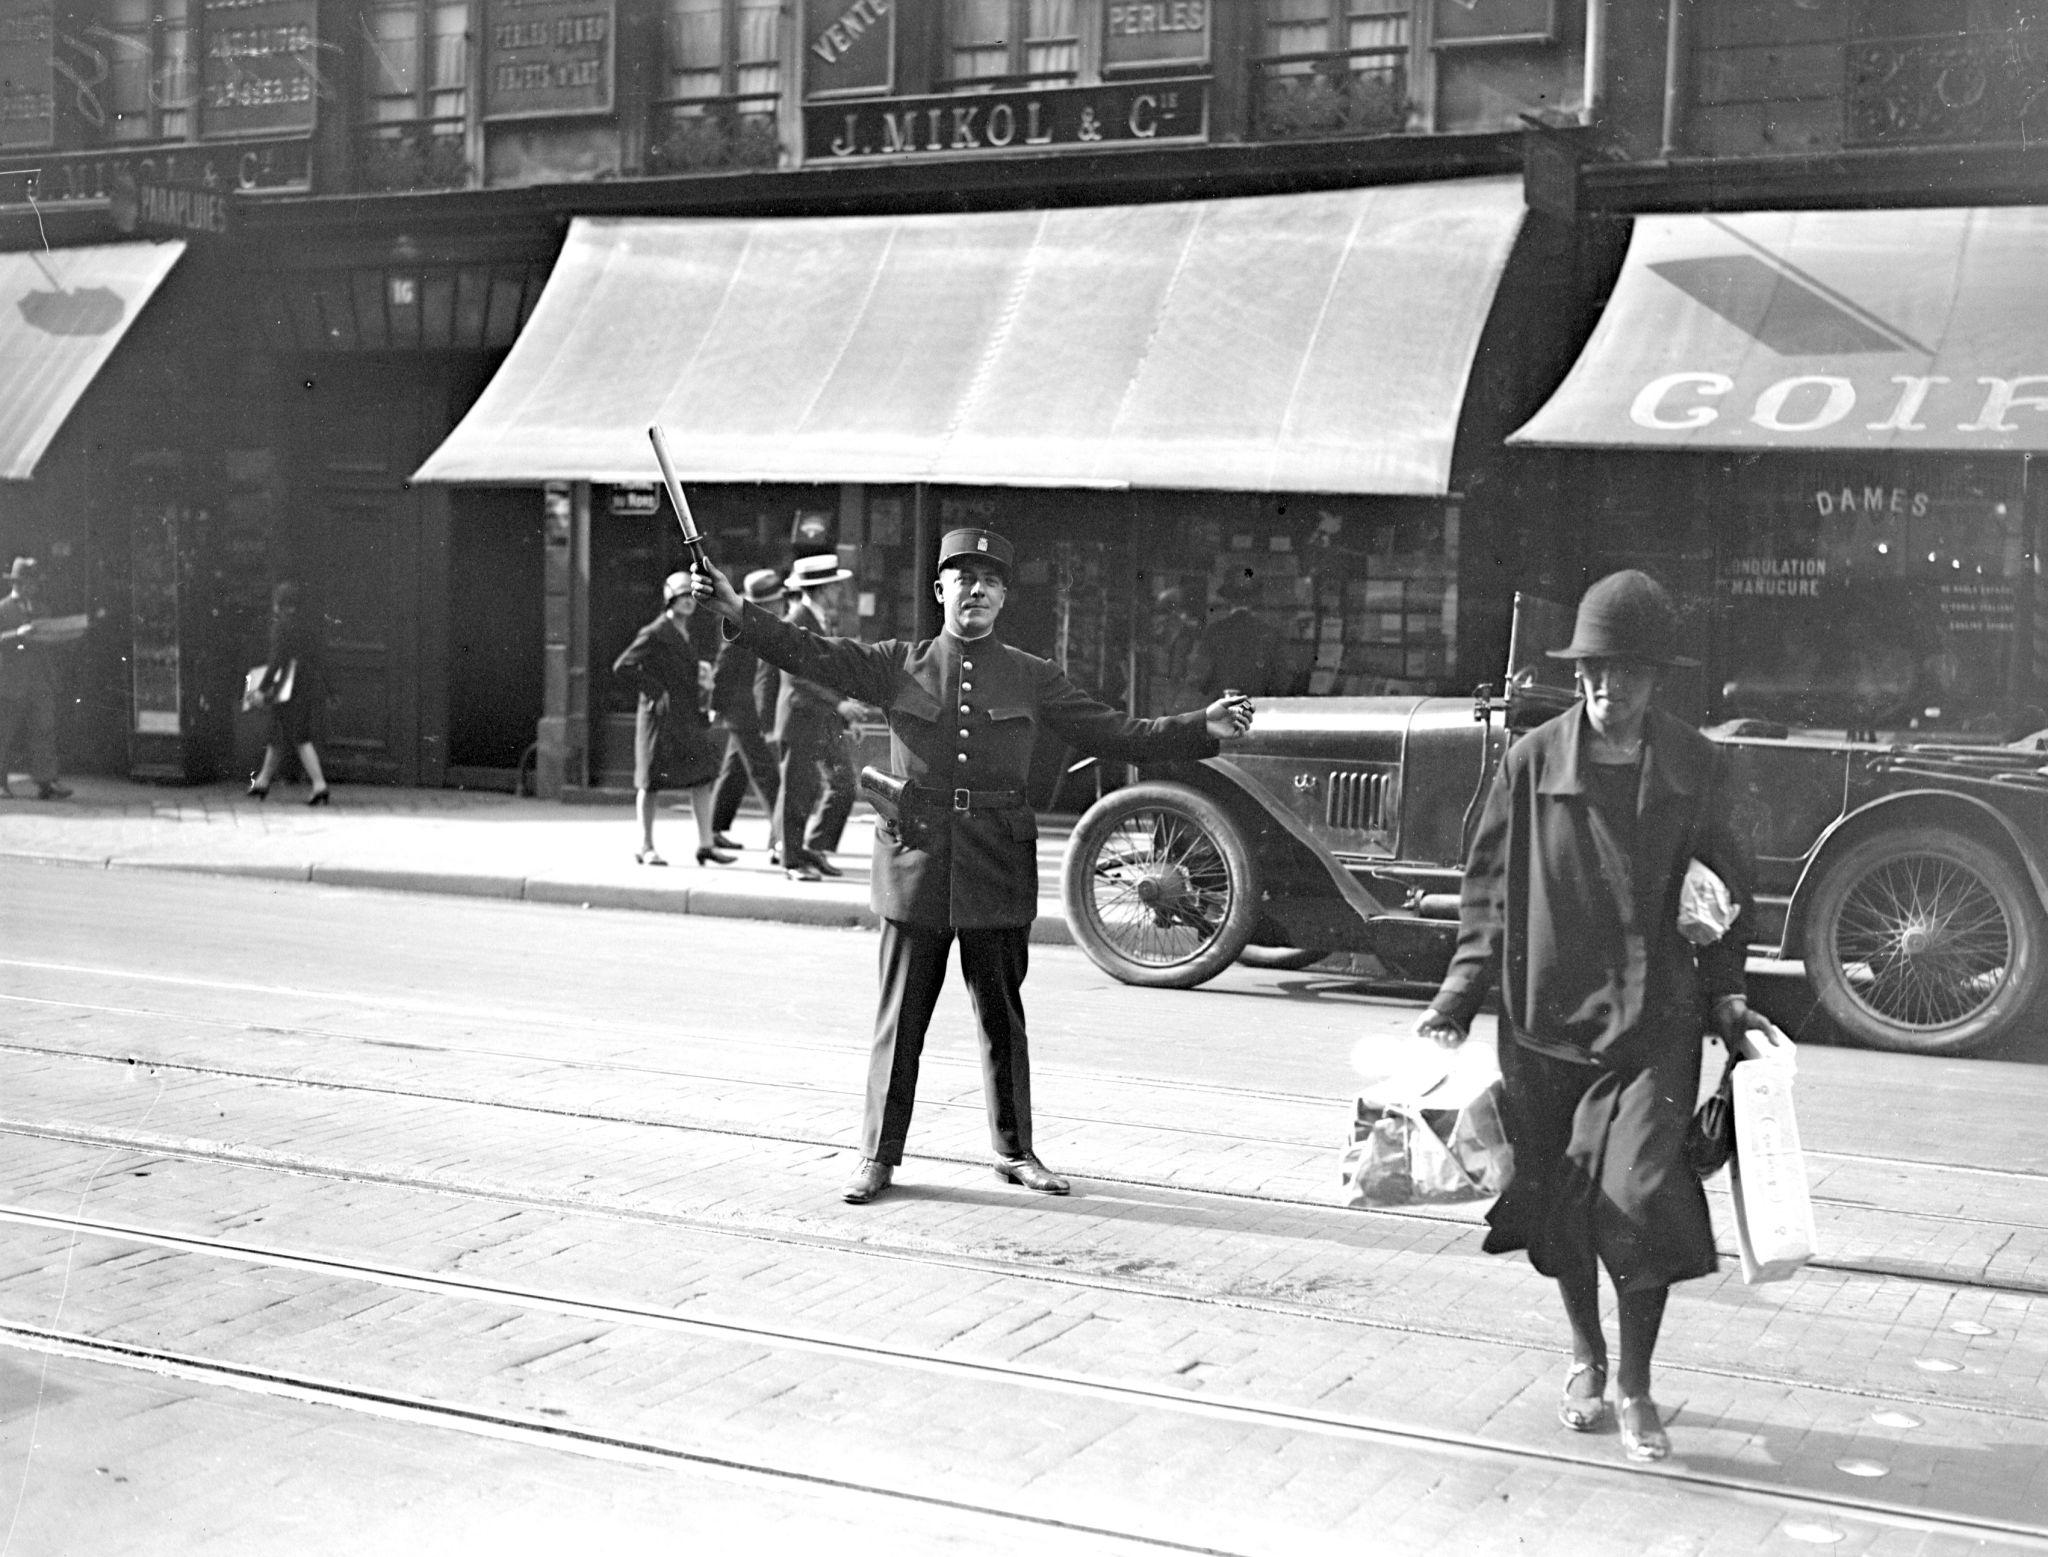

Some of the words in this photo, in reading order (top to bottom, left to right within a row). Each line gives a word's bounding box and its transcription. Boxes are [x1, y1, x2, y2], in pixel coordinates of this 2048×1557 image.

[1107, 1, 1204, 35] PERLES
[828, 113, 869, 155] J.
[880, 101, 1052, 153] MIKOL
[1076, 106, 1103, 141] &
[1816, 486, 1929, 519] DAMES
[1731, 578, 1820, 598] MANUCURE
